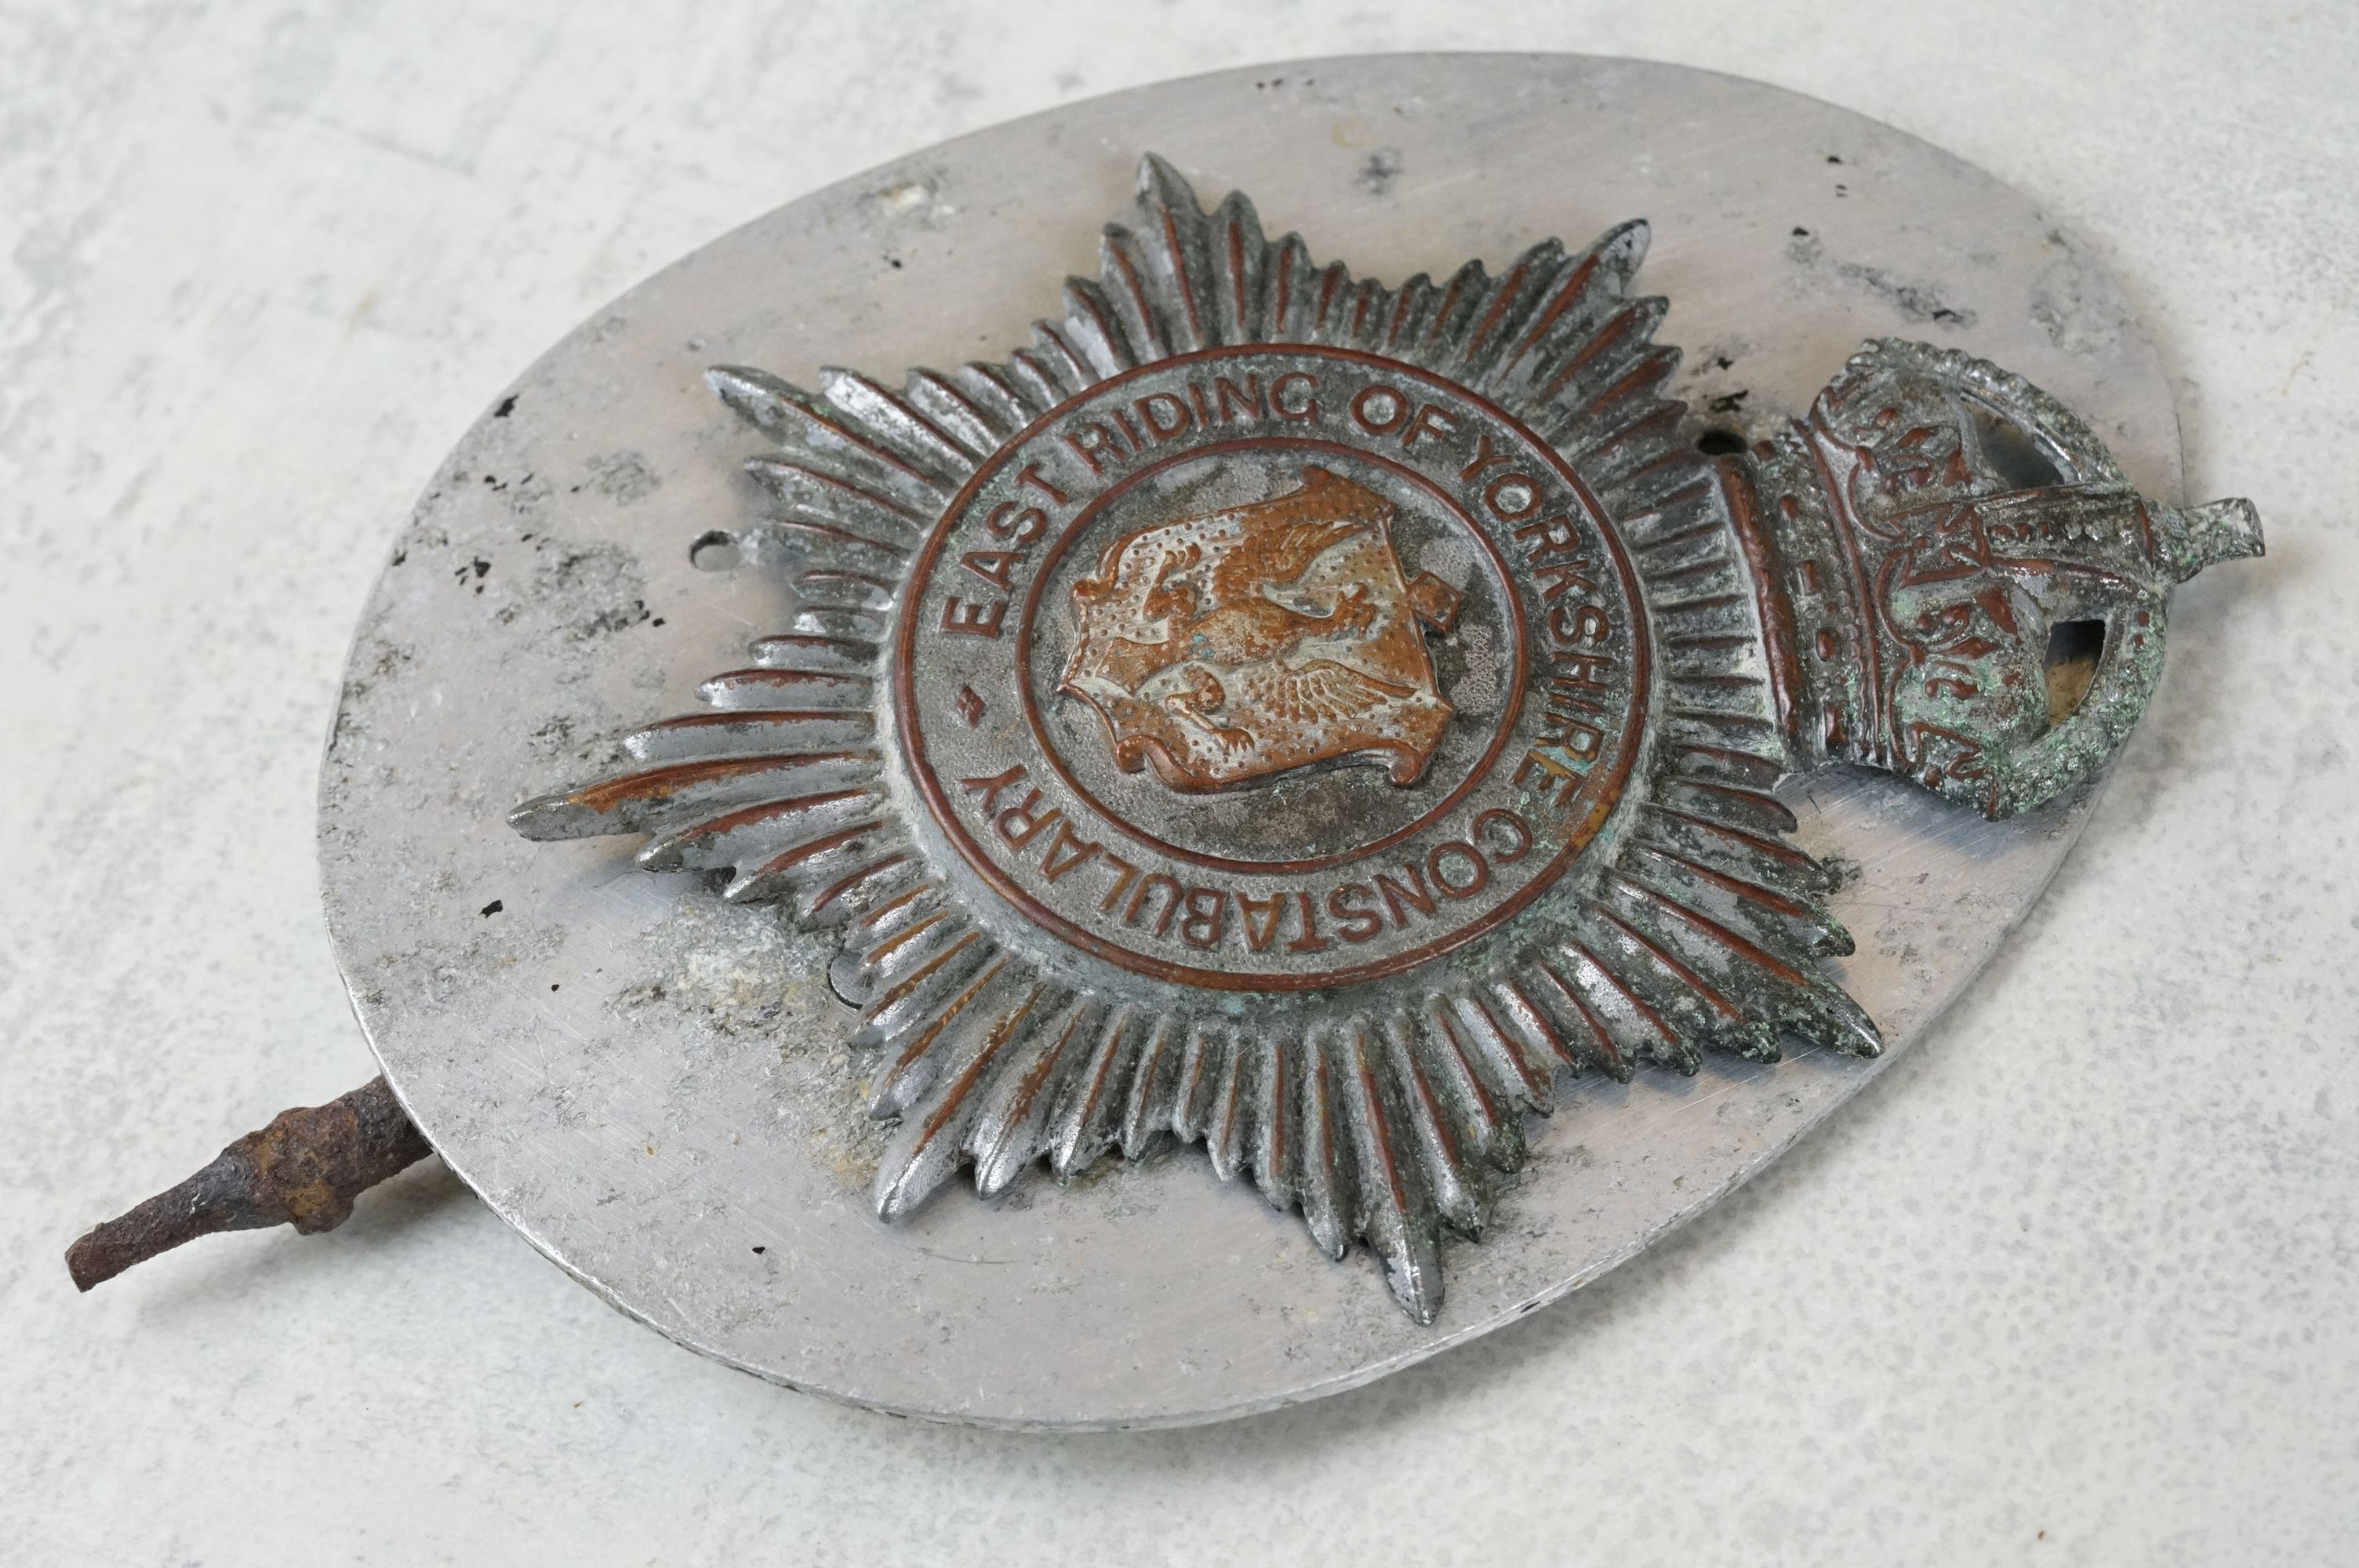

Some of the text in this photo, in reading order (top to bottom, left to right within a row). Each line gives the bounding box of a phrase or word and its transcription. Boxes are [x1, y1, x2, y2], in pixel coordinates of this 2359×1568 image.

[940, 372, 1611, 953] EAST RIDING OF YORKSHIRE CONSTABULARY
